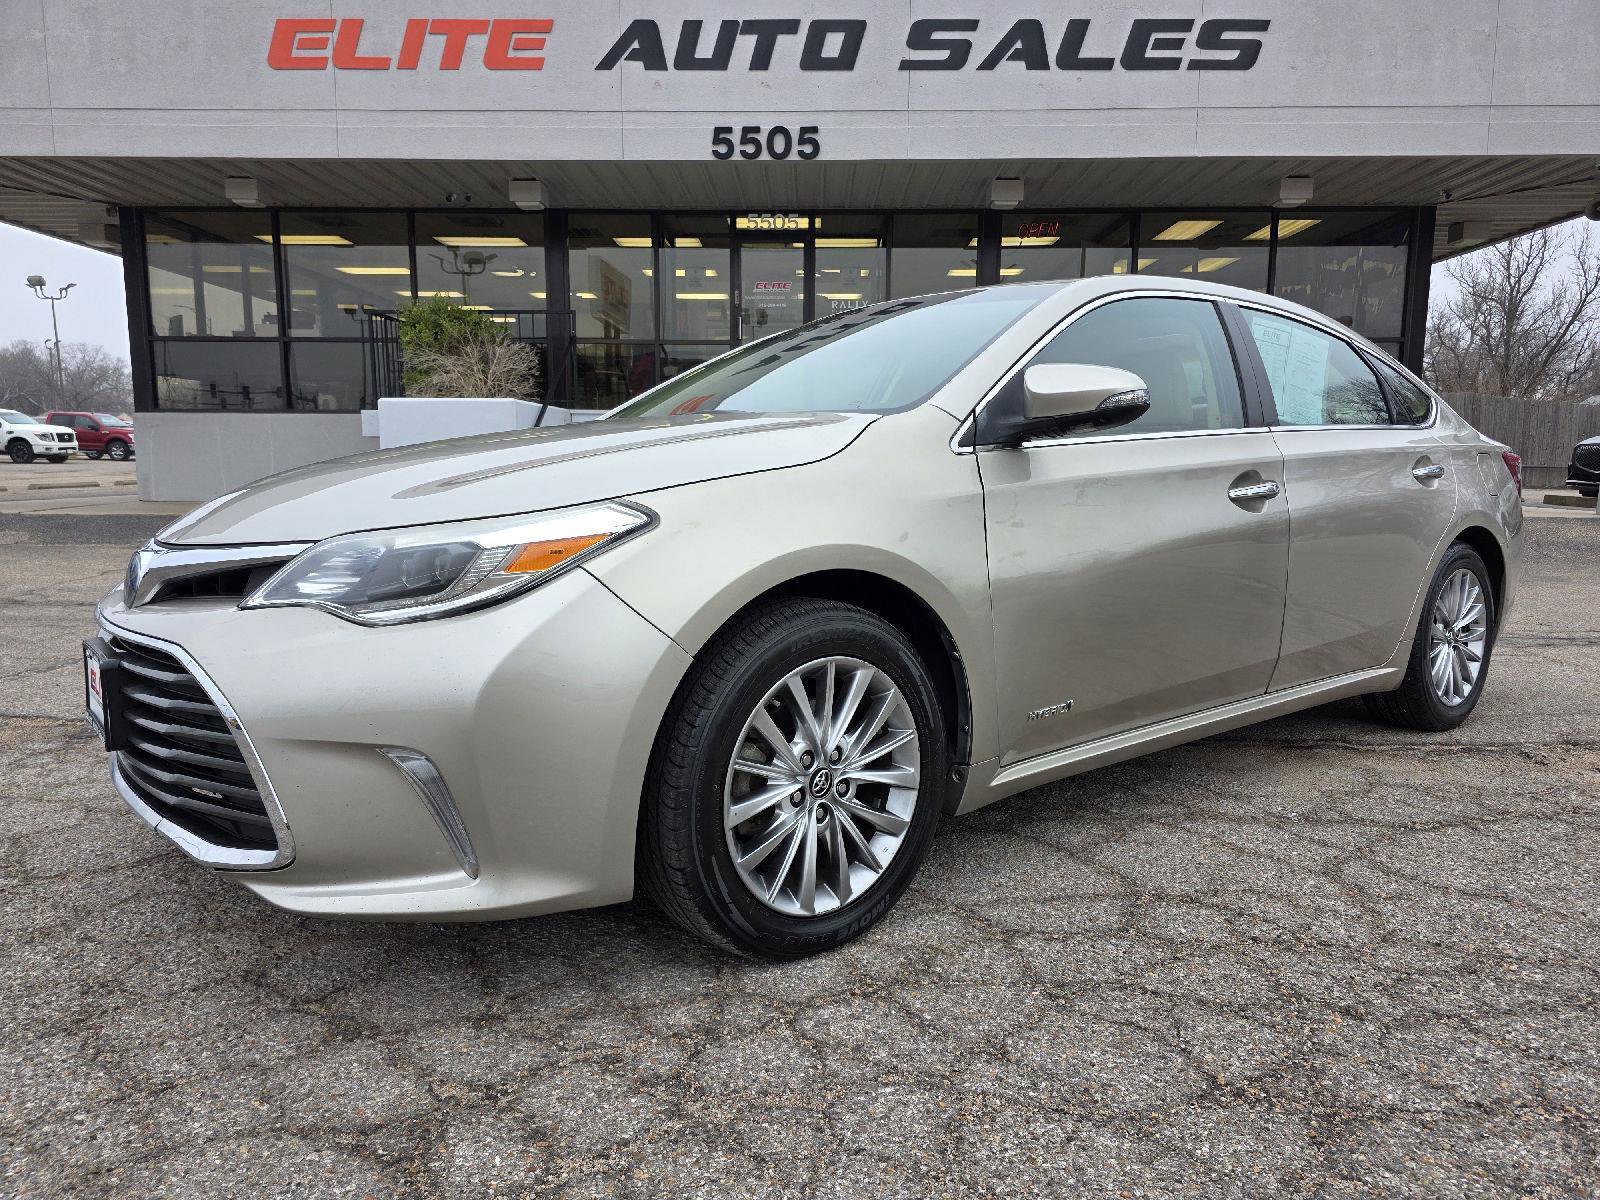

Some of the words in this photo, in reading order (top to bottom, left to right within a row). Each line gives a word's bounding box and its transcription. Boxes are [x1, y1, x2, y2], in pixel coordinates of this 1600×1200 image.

[267, 18, 554, 71] ELITE
[594, 18, 867, 71] AUTO
[898, 18, 1271, 71] SALES
[711, 125, 821, 160] 5505
[746, 213, 799, 230] 5505
[1018, 219, 1060, 238] OPEN
[831, 300, 869, 311] RALLY
